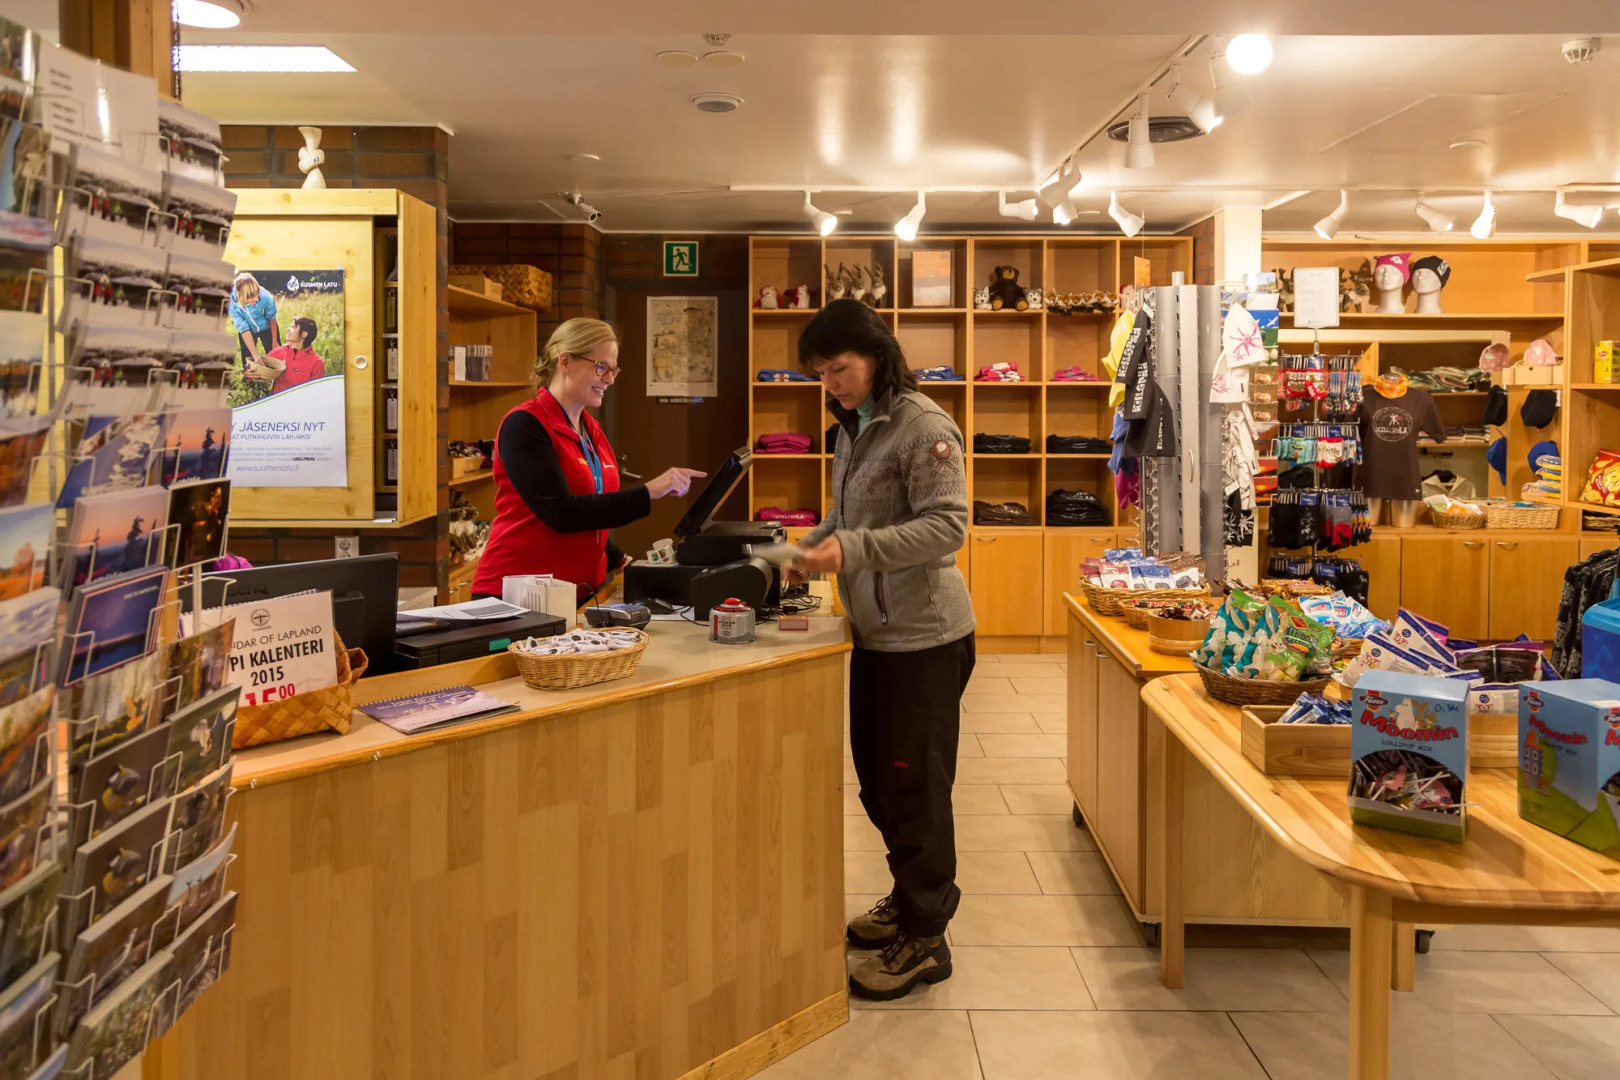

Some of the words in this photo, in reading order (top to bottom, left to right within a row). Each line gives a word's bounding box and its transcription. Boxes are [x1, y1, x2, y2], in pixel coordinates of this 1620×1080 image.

[239, 420, 300, 432] JÄSENEKSI
[303, 422, 325, 432] NYT
[236, 464, 300, 473] www.suomenlatu.fi
[259, 634, 275, 645] OF
[277, 625, 322, 641] LAPLAND
[230, 655, 245, 672] PI
[250, 638, 324, 667] KALENTERI
[250, 666, 284, 687] 2015
[1360, 709, 1459, 742] Moomin
[1528, 713, 1589, 745] Moomin
[1381, 739, 1415, 749] LOLLIPOP
[1417, 744, 1433, 752] MIX
